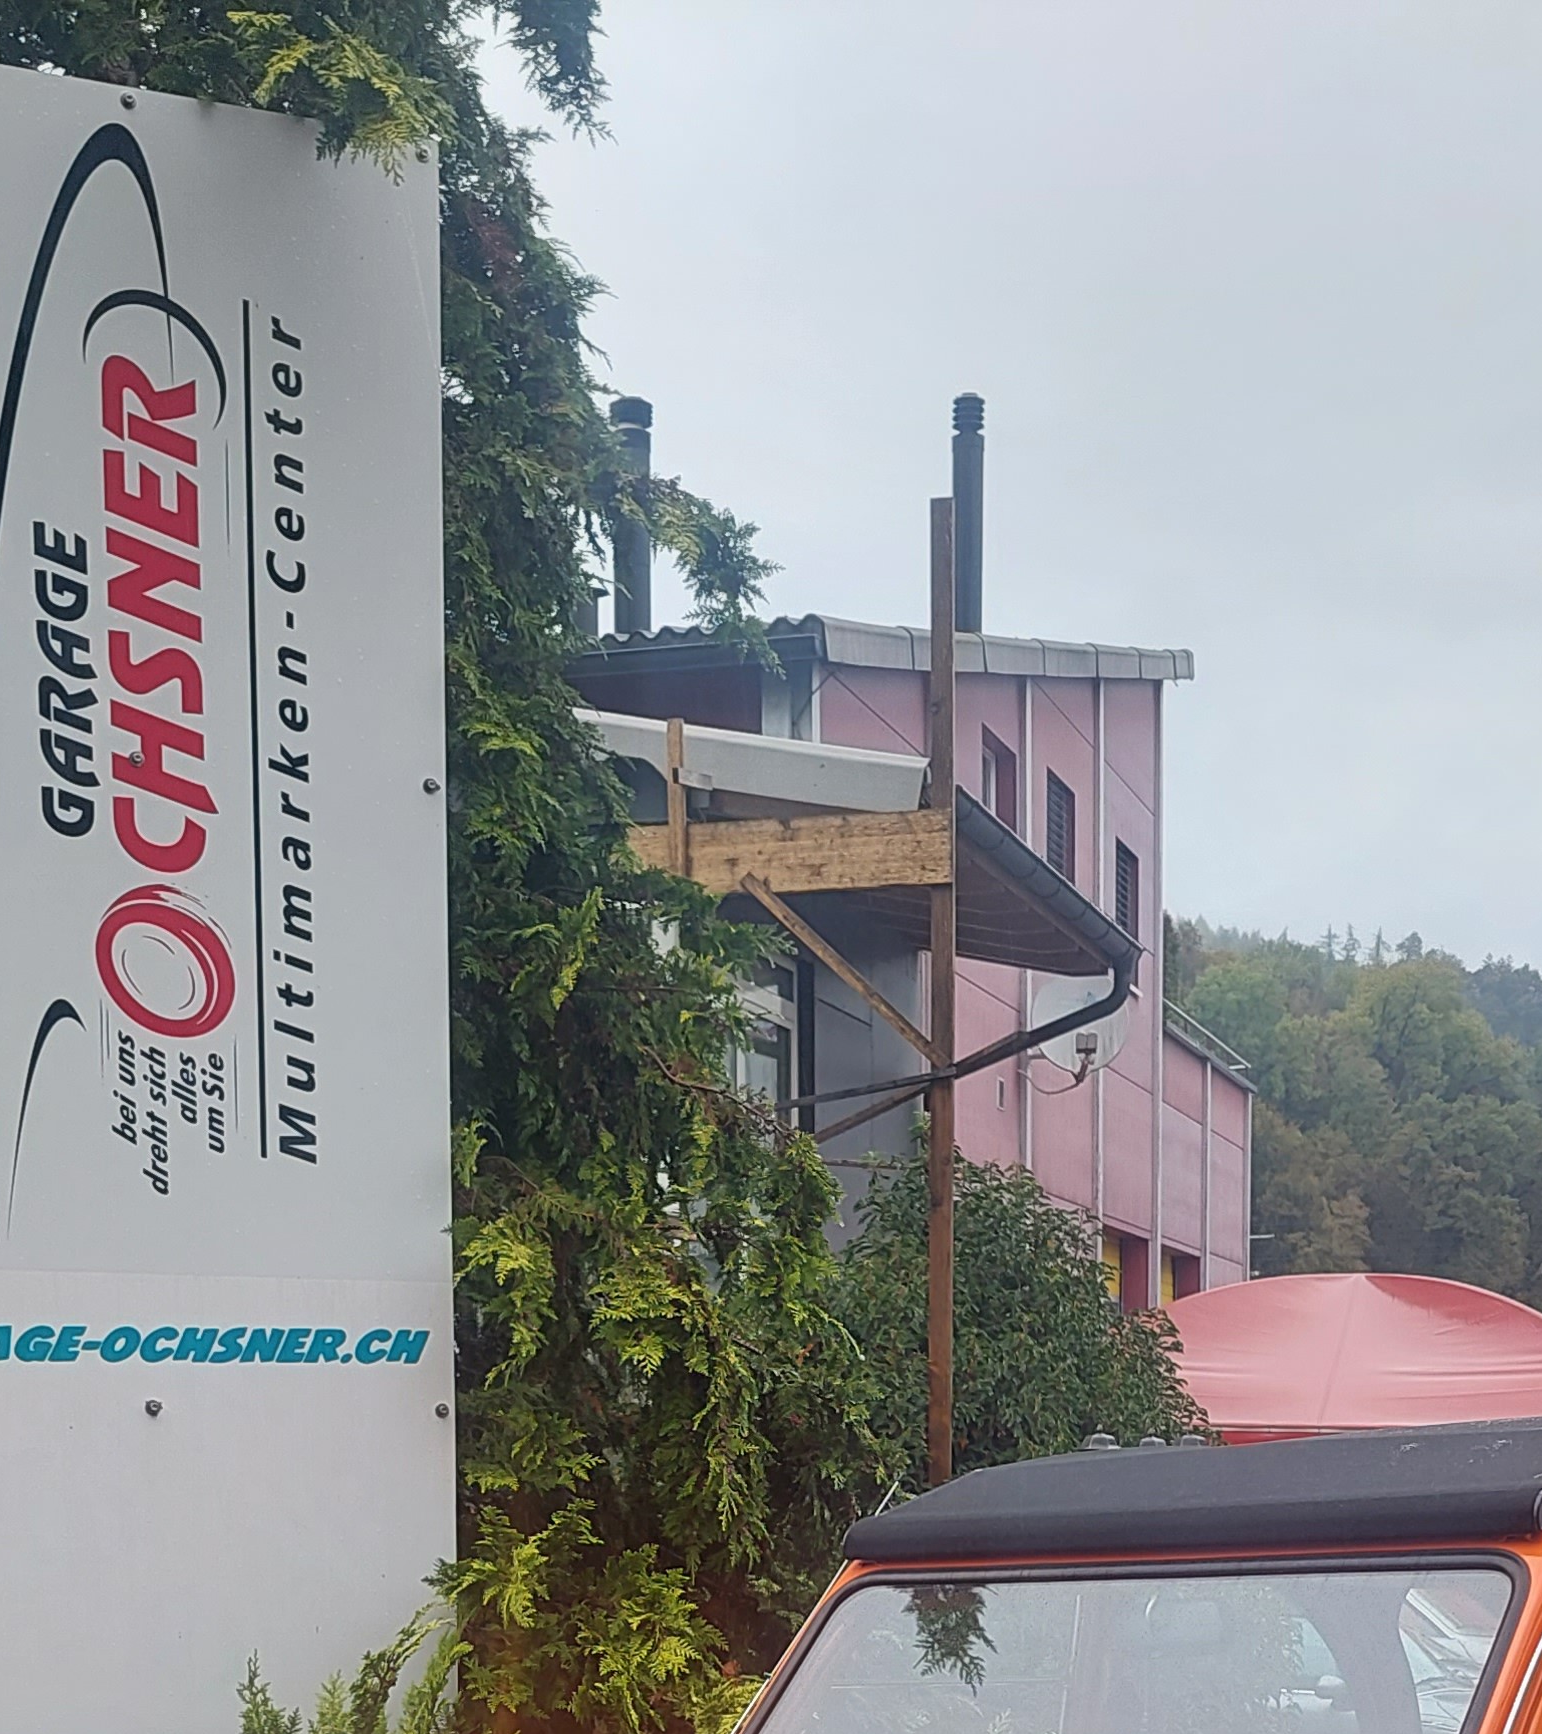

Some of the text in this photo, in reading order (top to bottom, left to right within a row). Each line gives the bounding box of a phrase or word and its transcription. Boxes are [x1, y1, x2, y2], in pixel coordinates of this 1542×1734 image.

[32, 520, 101, 838] GARAGE
[95, 355, 235, 1038] OCHSNER
[265, 316, 317, 1165] Multimarken-Center
[112, 1029, 138, 1145] bei uns
[139, 1045, 170, 1196] dreht sich
[171, 1052, 198, 1125] alles
[200, 1052, 226, 1154] um Sie
